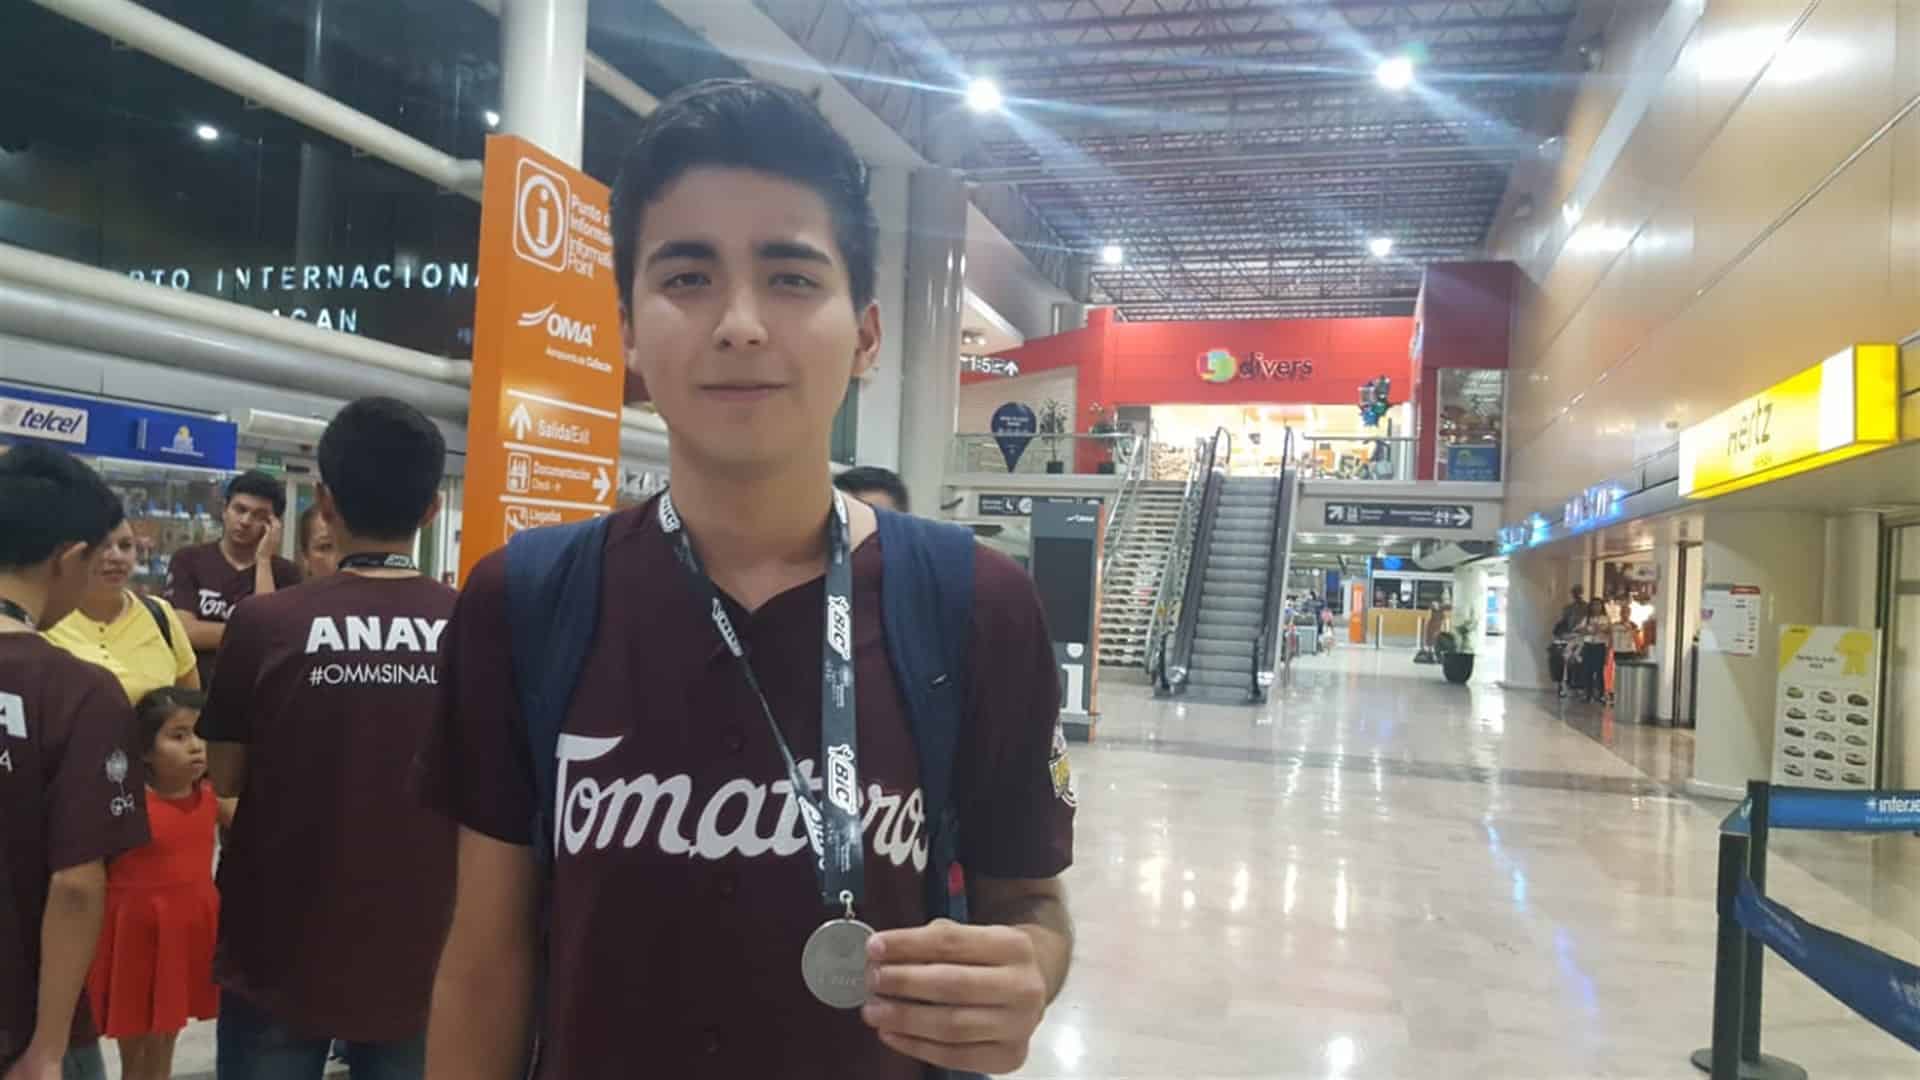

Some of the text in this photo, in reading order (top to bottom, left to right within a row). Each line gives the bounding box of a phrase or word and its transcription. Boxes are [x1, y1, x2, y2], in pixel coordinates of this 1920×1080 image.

[546, 313, 593, 347] OMA
[1239, 351, 1313, 379] divers
[19, 407, 83, 434] telcel
